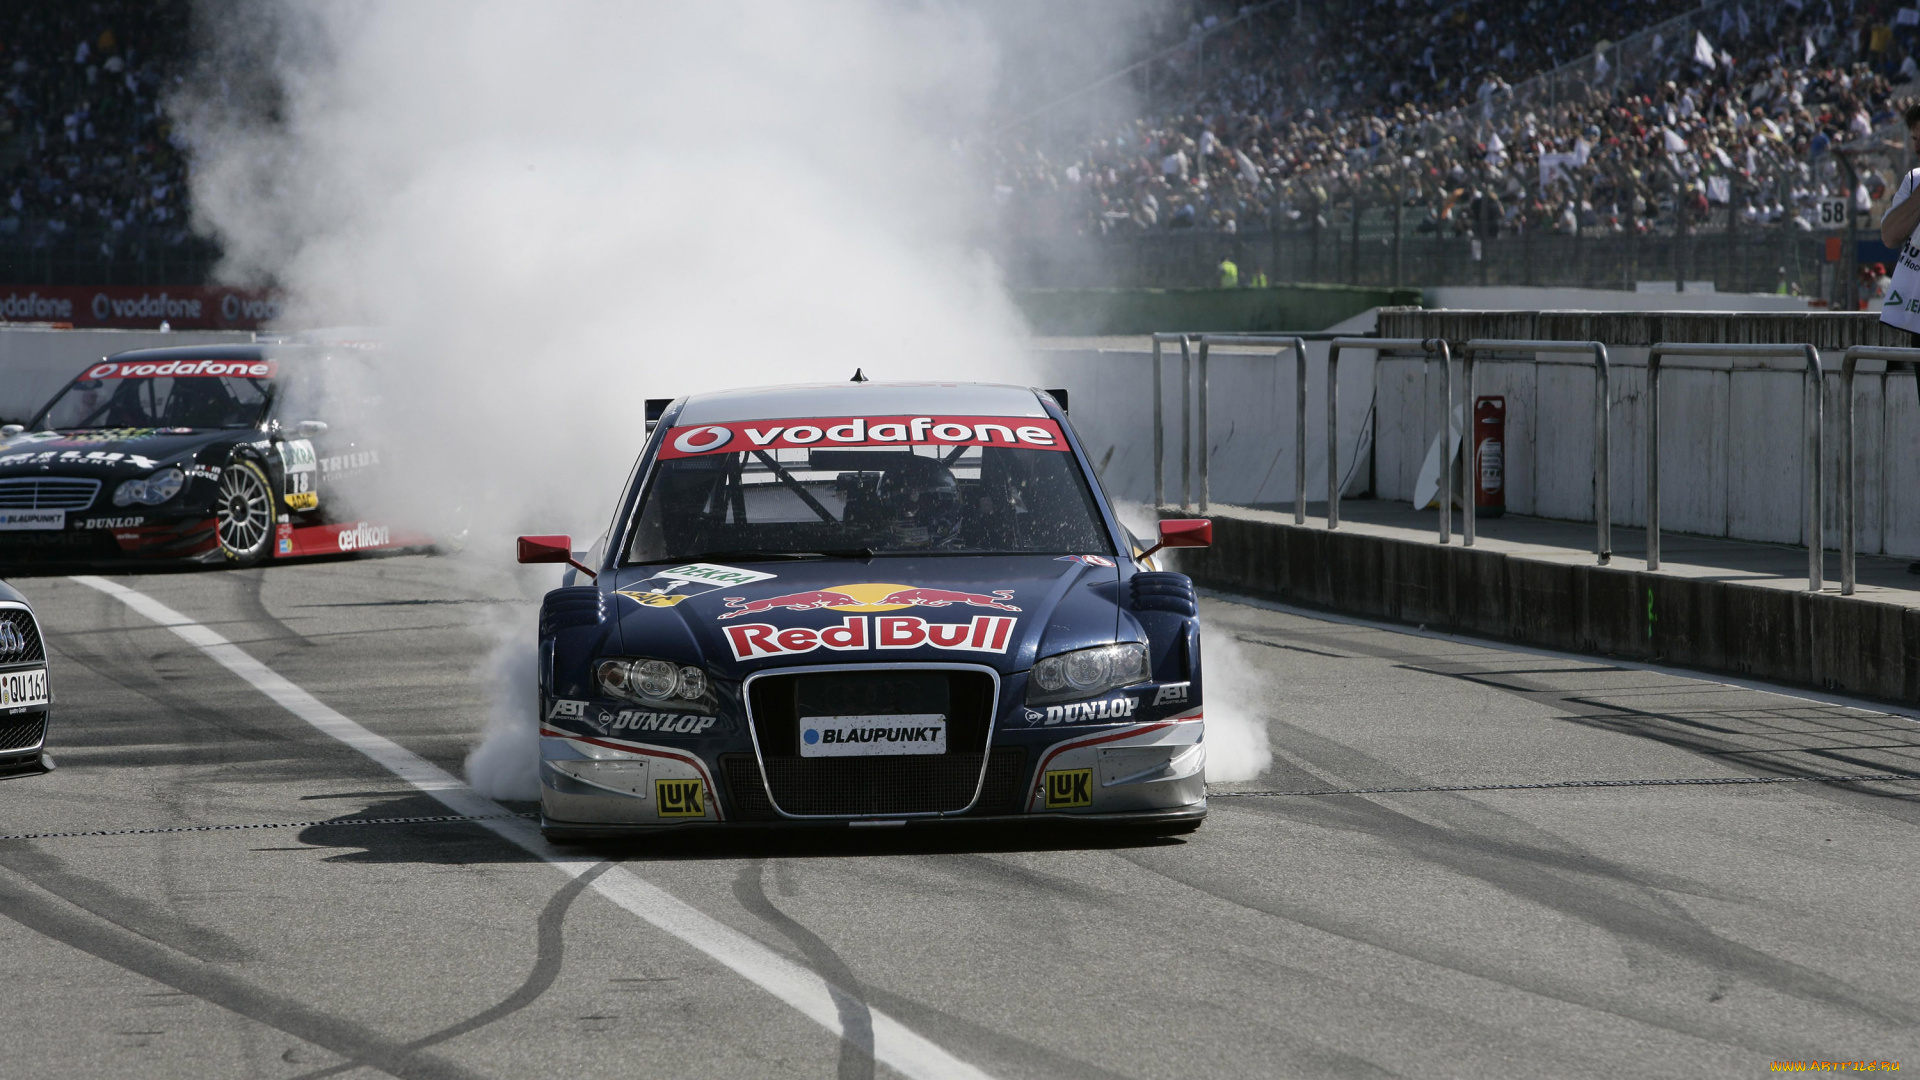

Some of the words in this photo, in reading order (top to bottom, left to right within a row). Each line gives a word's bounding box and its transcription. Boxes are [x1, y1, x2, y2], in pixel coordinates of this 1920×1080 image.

[1821, 201, 1845, 224] 58
[111, 292, 202, 318] vodafone
[121, 360, 269, 377] vodafone
[743, 417, 1059, 446] vodafone
[319, 450, 380, 473] TRILUX
[292, 471, 309, 494] 18
[7, 513, 62, 524] BLAUPUNKT
[85, 516, 144, 530] DUNLOP
[666, 565, 757, 585] DEKRA
[724, 616, 867, 661] Red
[876, 616, 1016, 653] Bull
[10, 675, 27, 703] QU
[28, 672, 47, 701] 161
[1152, 681, 1191, 707] ABT
[549, 699, 590, 719] ABT
[1044, 696, 1140, 726] DUNLOP
[613, 710, 717, 735] DUNLOP
[822, 727, 942, 744] BLAUPUNKT
